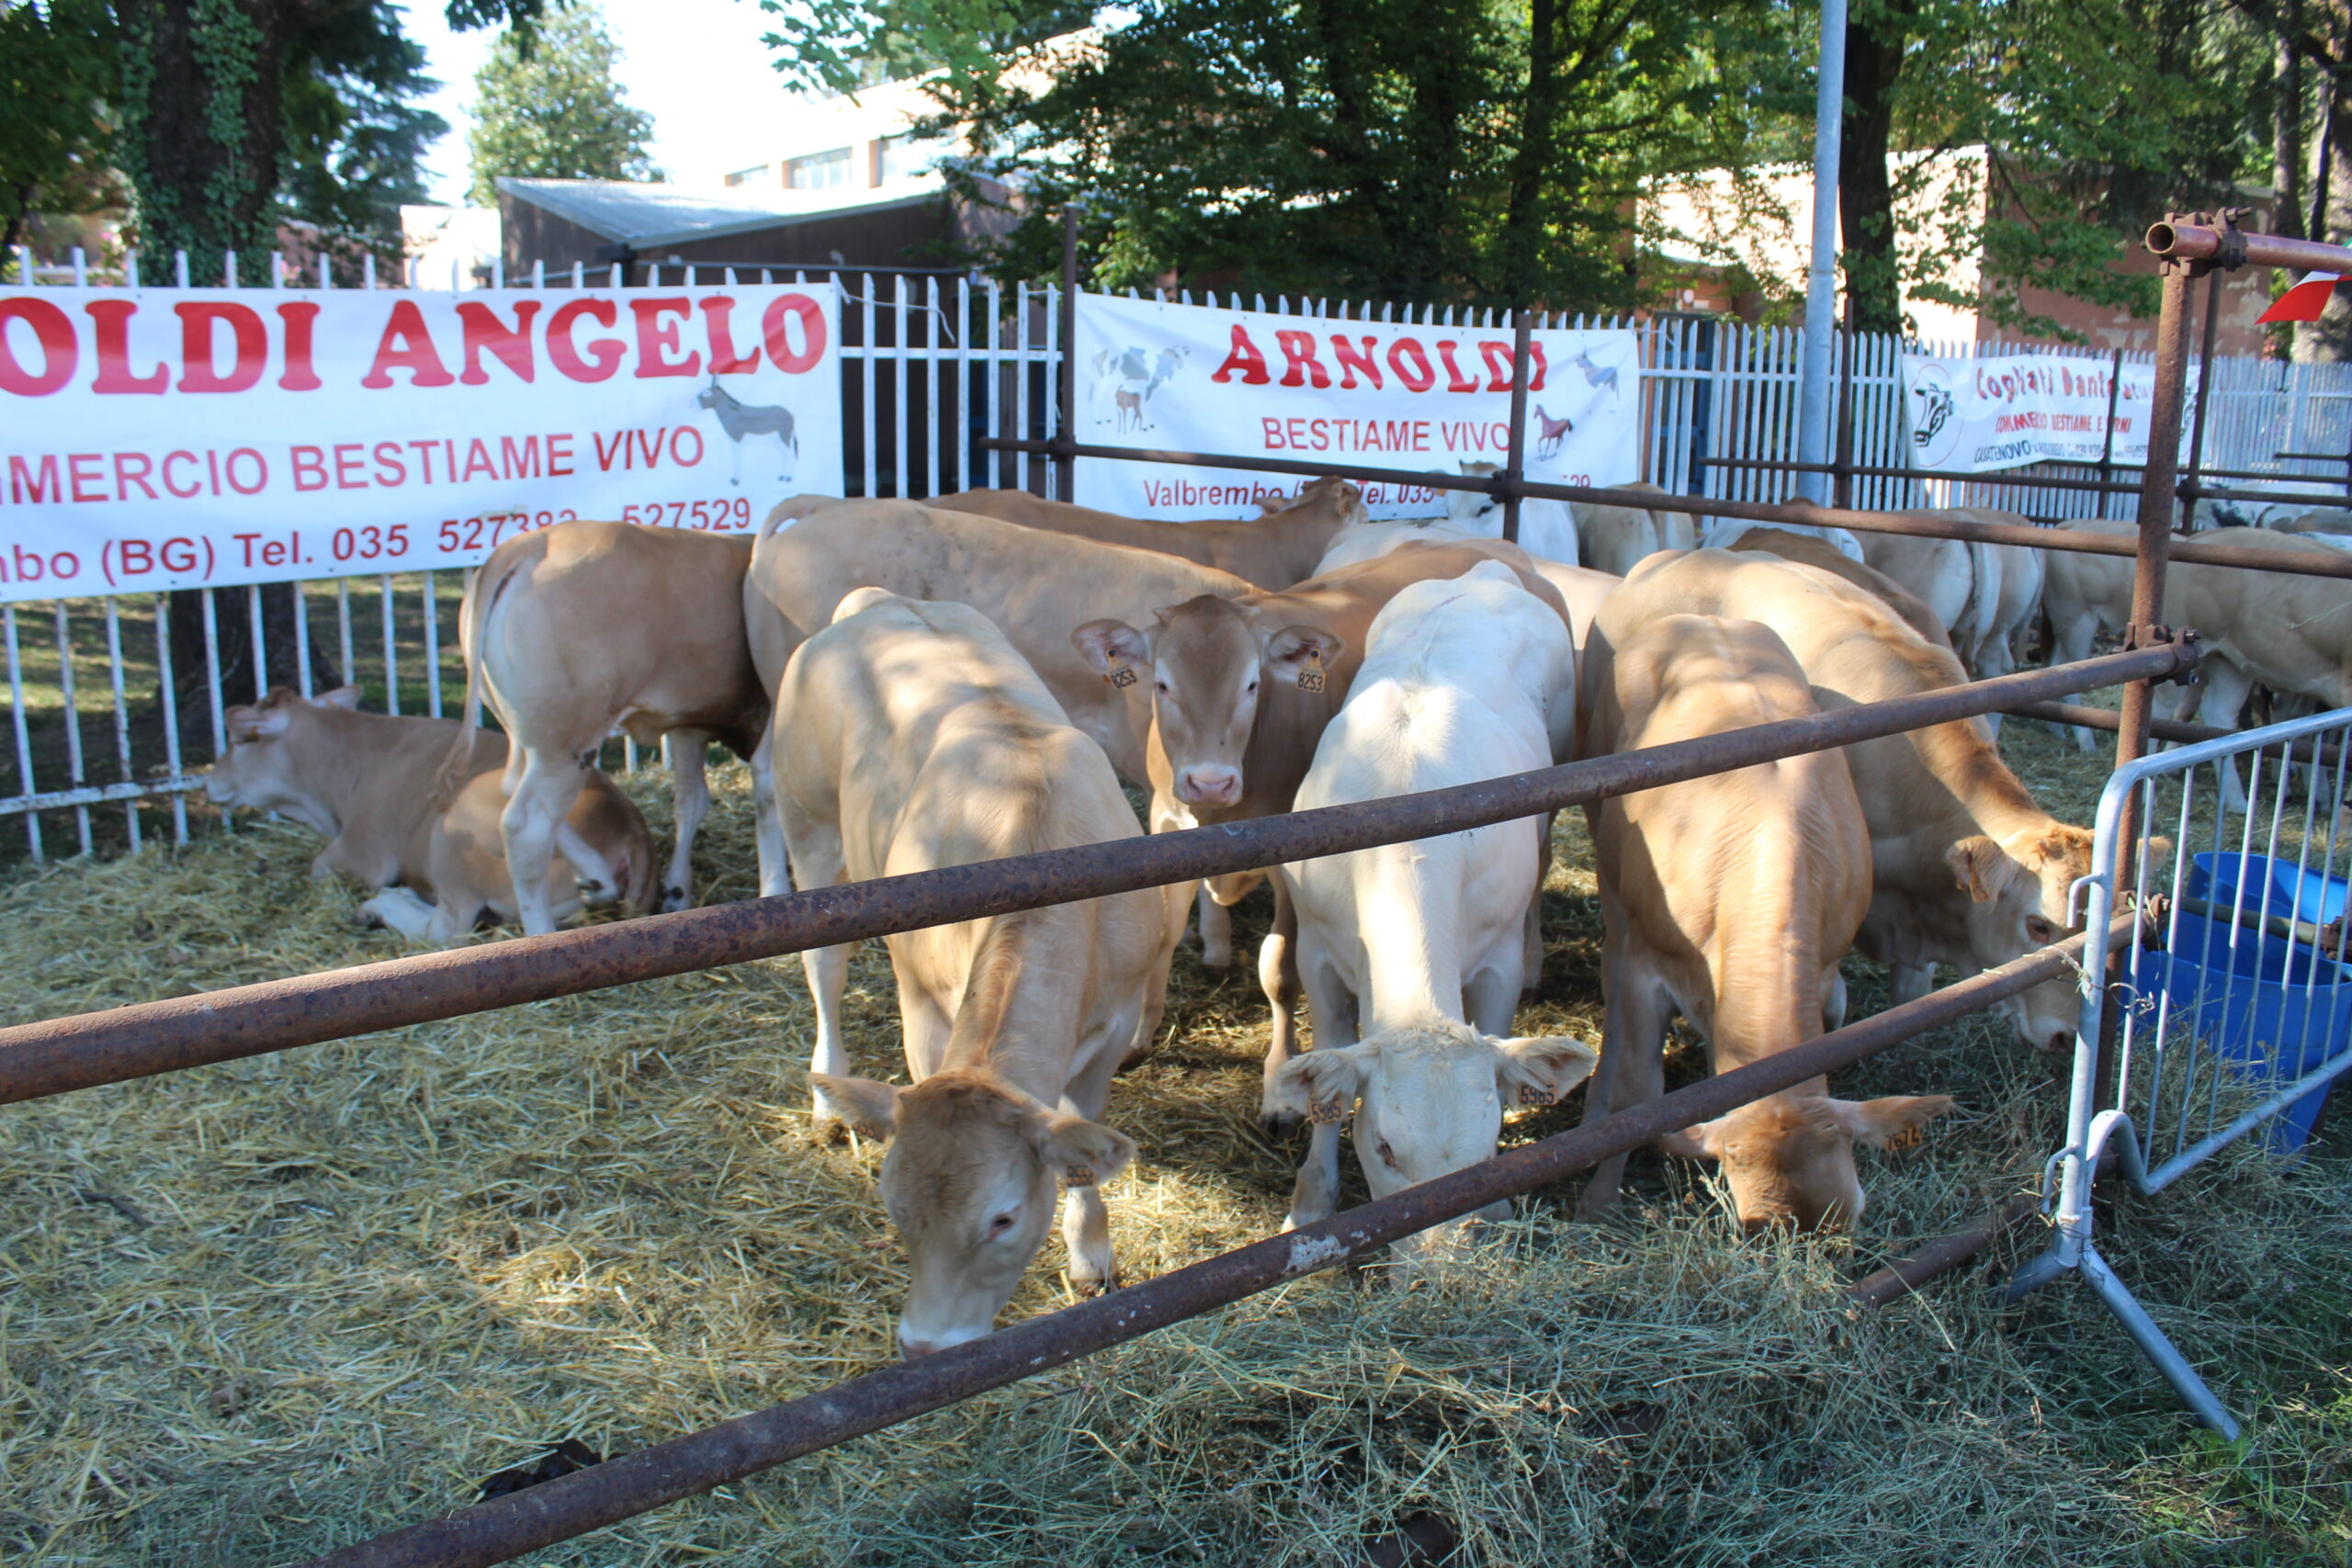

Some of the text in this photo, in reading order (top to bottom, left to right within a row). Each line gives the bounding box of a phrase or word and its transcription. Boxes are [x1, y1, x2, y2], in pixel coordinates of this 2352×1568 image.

[362, 293, 827, 389] ANGELO
[1211, 323, 1548, 393] ARNOLDI
[0, 425, 705, 505] MERCIO BESTIAME VIVO
[1261, 417, 1511, 452] BESTIAME VIVO
[101, 536, 215, 587] (BG)
[233, 531, 313, 568] Tel.
[333, 524, 409, 561] 035
[1111, 669, 1137, 689] 8253
[1297, 671, 1323, 692] 8253
